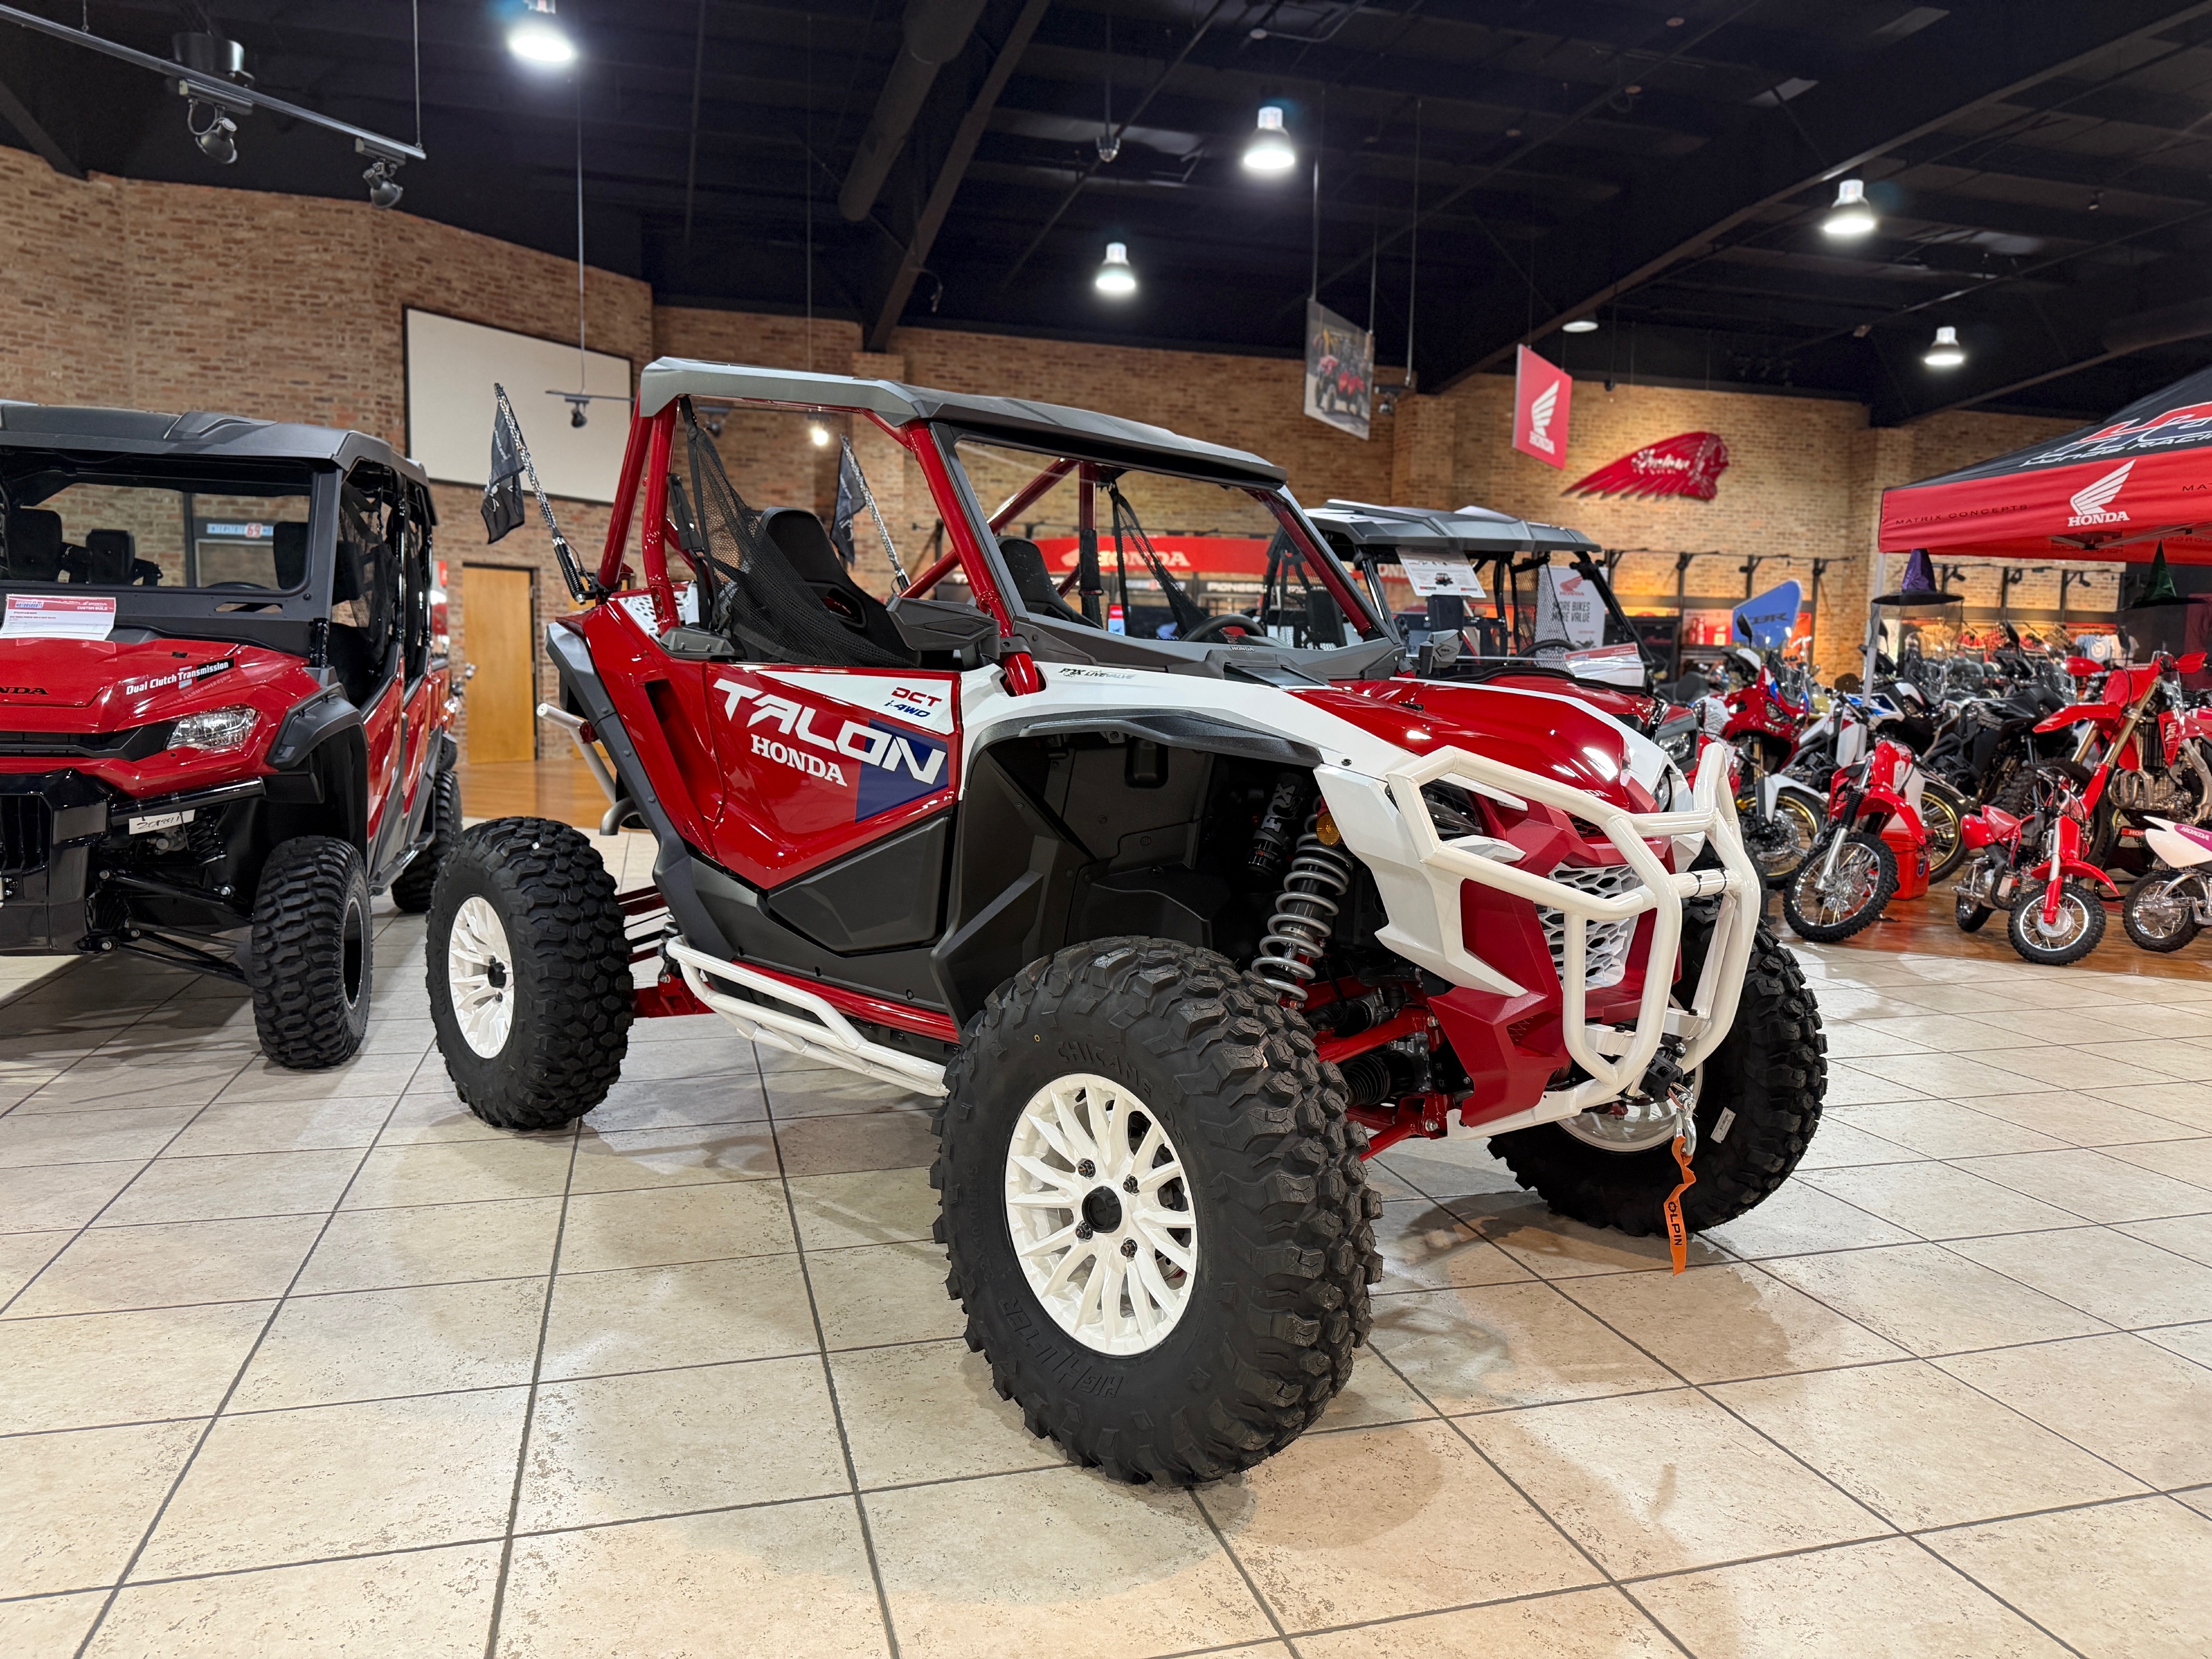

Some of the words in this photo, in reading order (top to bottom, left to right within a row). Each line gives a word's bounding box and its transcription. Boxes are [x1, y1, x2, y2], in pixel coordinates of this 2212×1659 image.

[1530, 431, 1554, 454] HONDA
[2128, 433, 2212, 450] RACI
[1896, 516, 1942, 524] MATRIX
[1949, 504, 2028, 519] CONCEPTS
[2067, 511, 2130, 527] HONDA
[247, 524, 261, 537] 69
[1572, 602, 1590, 611] BIKES
[1552, 612, 1570, 622] MRE
[1571, 612, 1590, 623] VALUE
[126, 681, 148, 695] Dual
[150, 675, 177, 689] Clutch
[177, 662, 229, 681] Transmission
[1059, 668, 1086, 677] FOX
[891, 687, 942, 707] DCT
[884, 700, 930, 718] i-4WD
[713, 678, 946, 785] TALON
[751, 734, 848, 787] HONDA
[1261, 783, 1295, 832] FOX
[2180, 826, 2210, 841] HONDA
